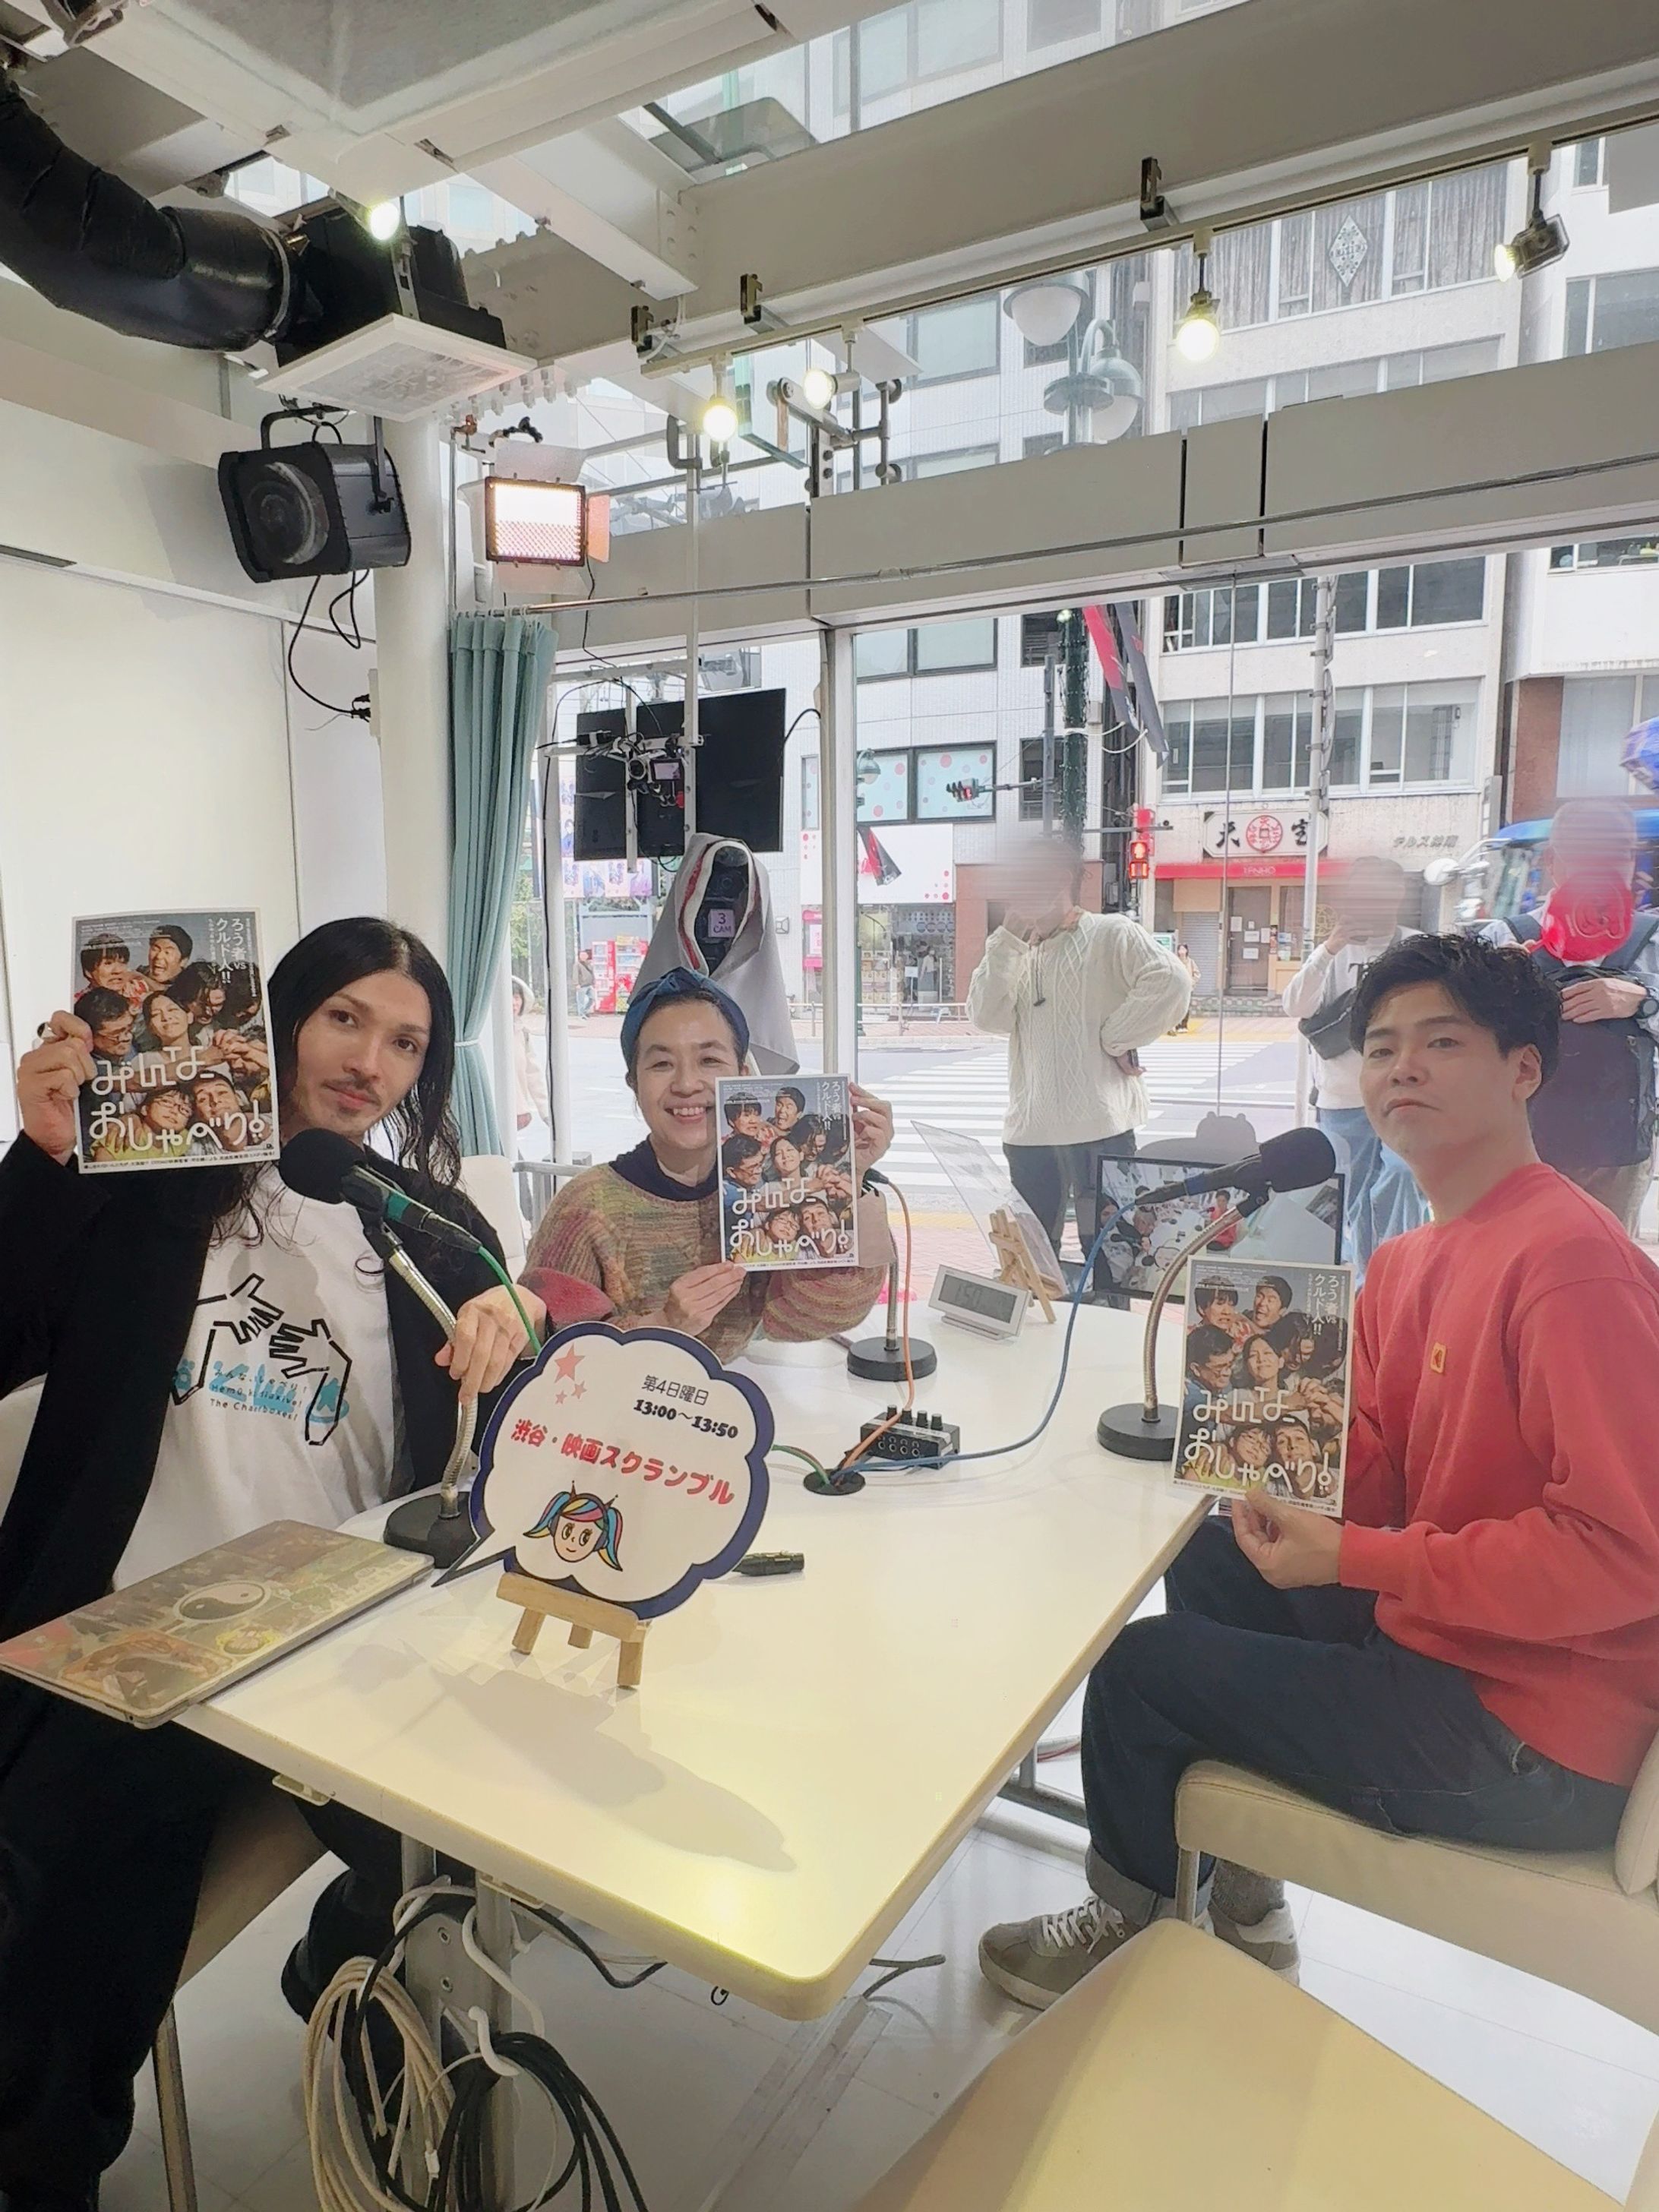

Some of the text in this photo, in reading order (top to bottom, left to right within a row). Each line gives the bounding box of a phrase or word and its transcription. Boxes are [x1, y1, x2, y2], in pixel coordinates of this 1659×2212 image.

[718, 912, 726, 924] 3
[713, 925, 732, 934] CAM
[642, 1374, 709, 1405] 第4日曜日
[210, 1398, 228, 1409] The
[511, 1418, 735, 1505] 渋谷・映画スクランブル
